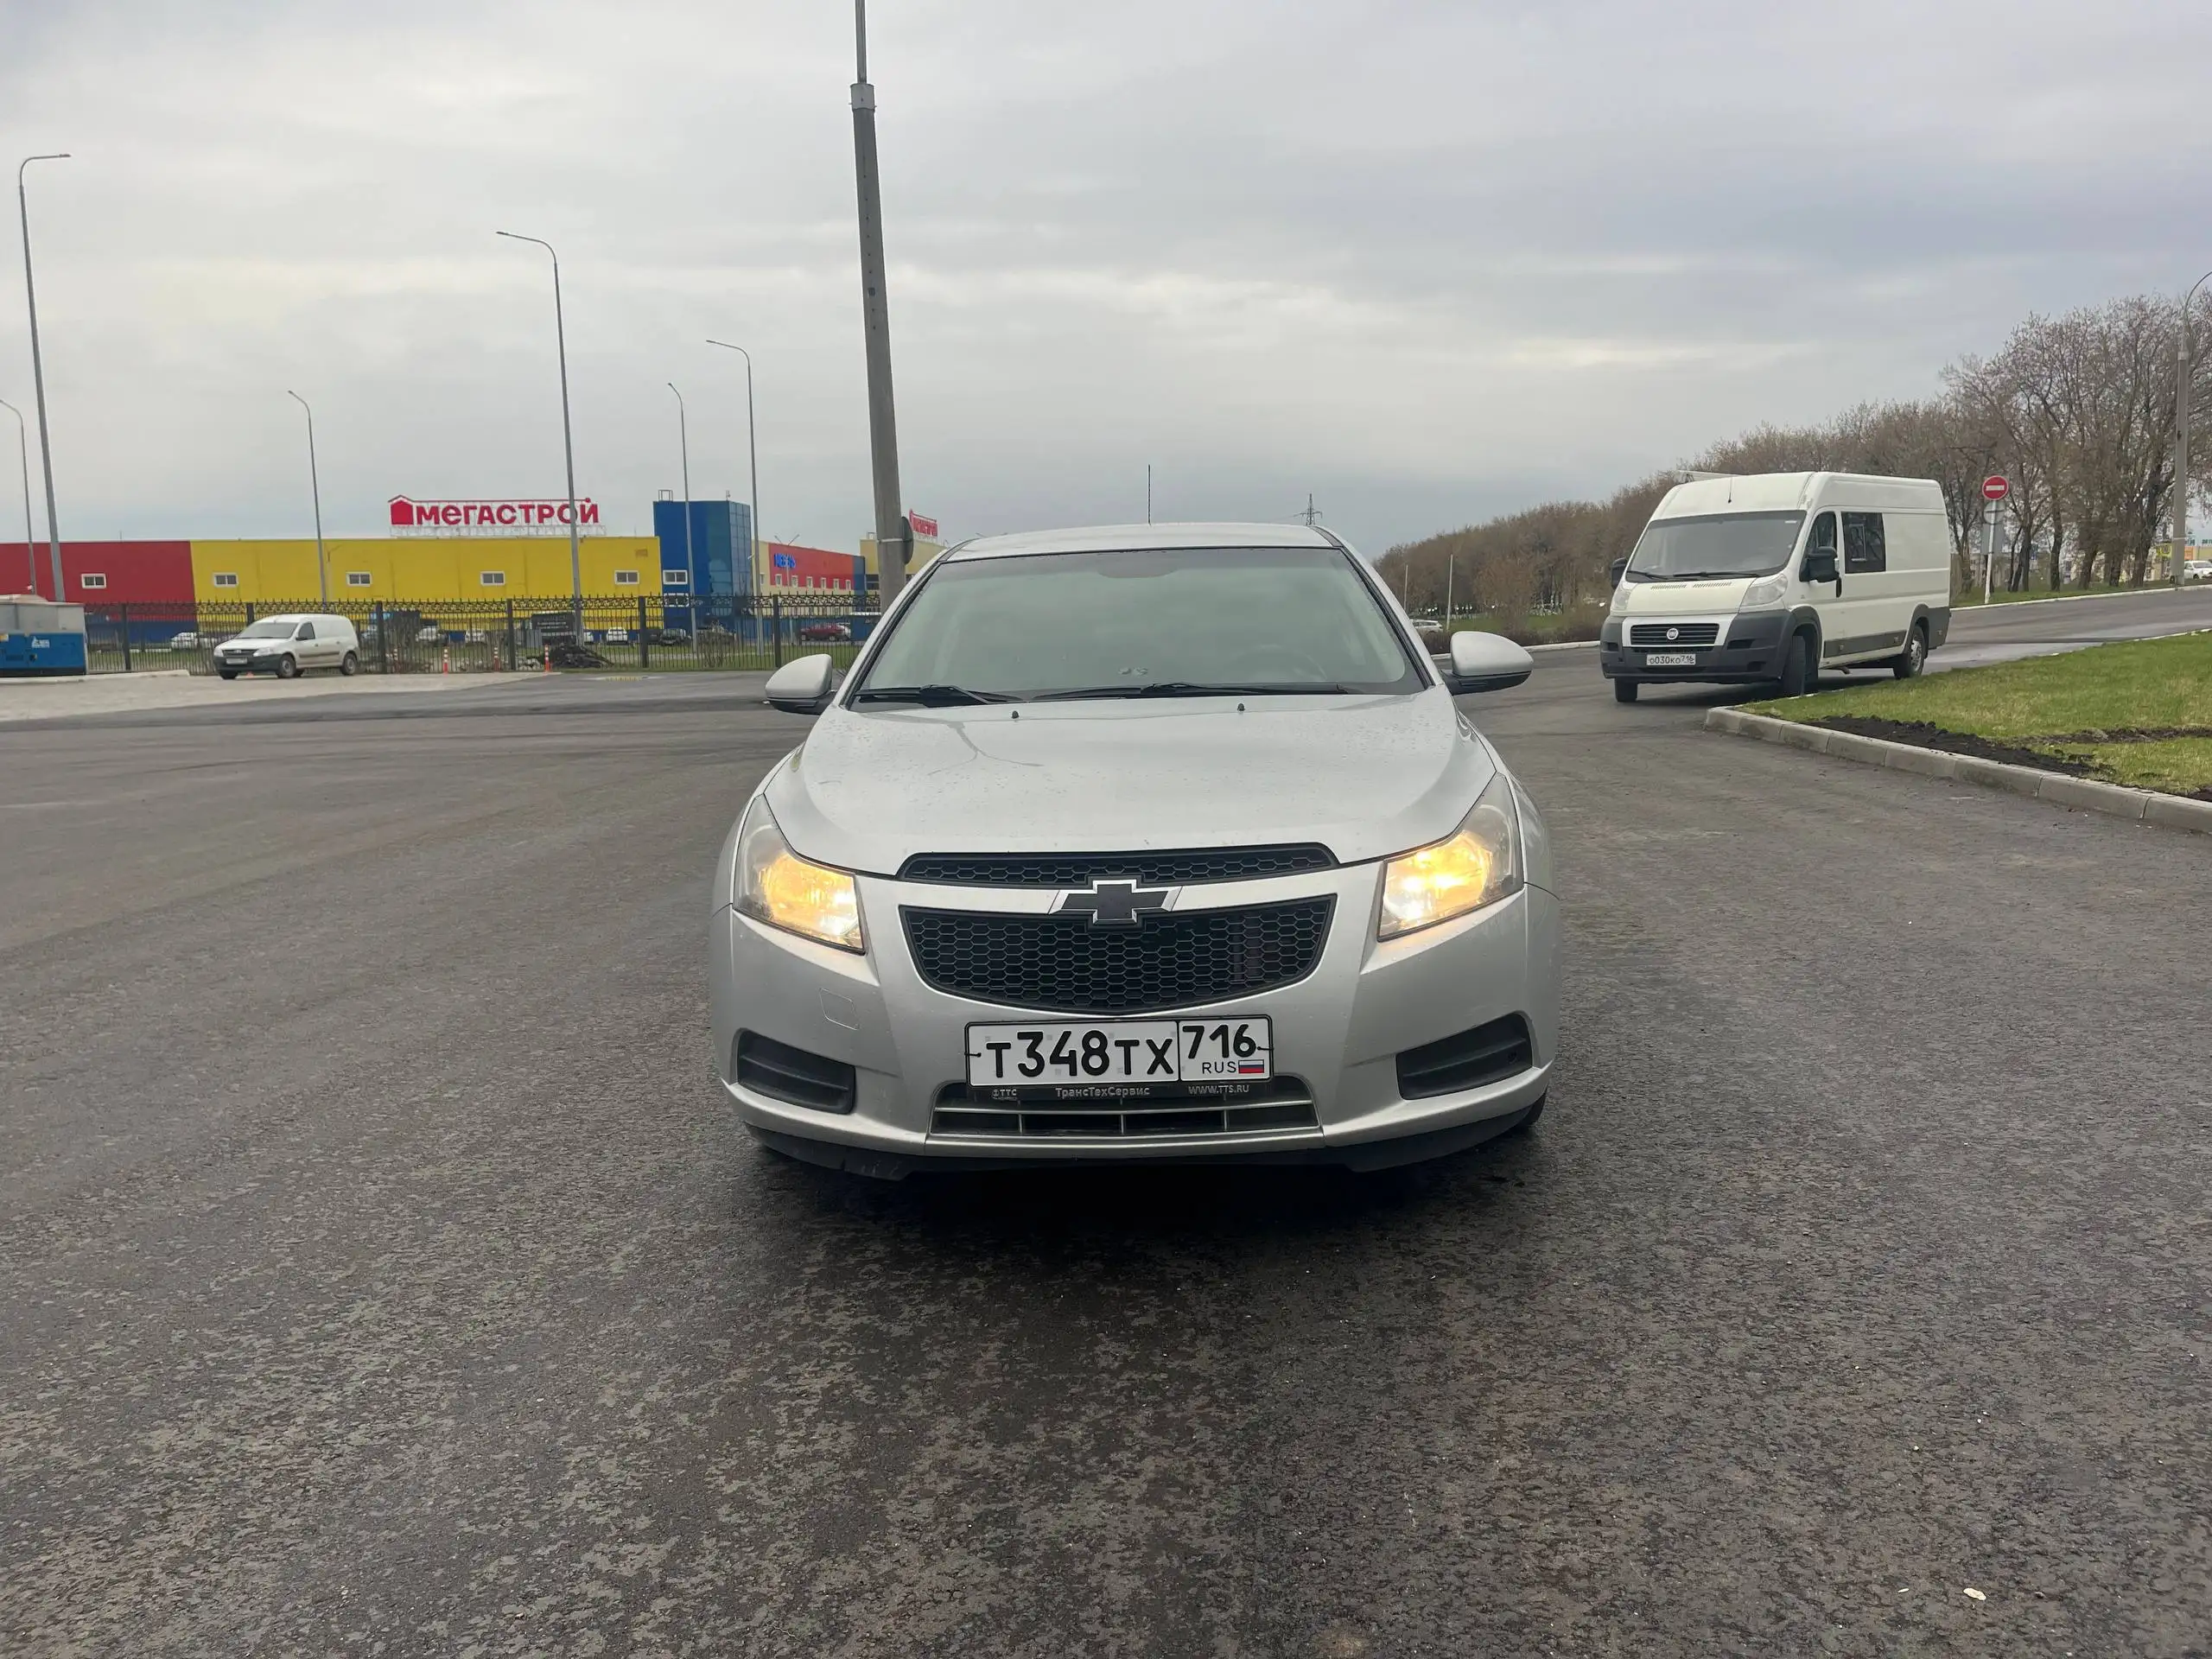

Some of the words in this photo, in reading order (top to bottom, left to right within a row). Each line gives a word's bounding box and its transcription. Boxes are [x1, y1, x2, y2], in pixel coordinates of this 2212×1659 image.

[986, 1029, 1174, 1078] Т348ТХ
[1182, 1024, 1256, 1059] 716
[1202, 1061, 1236, 1074] RUS
[1055, 1086, 1150, 1098] ТрансТехСервис
[1188, 1084, 1249, 1095] WWW.TTS.RU
